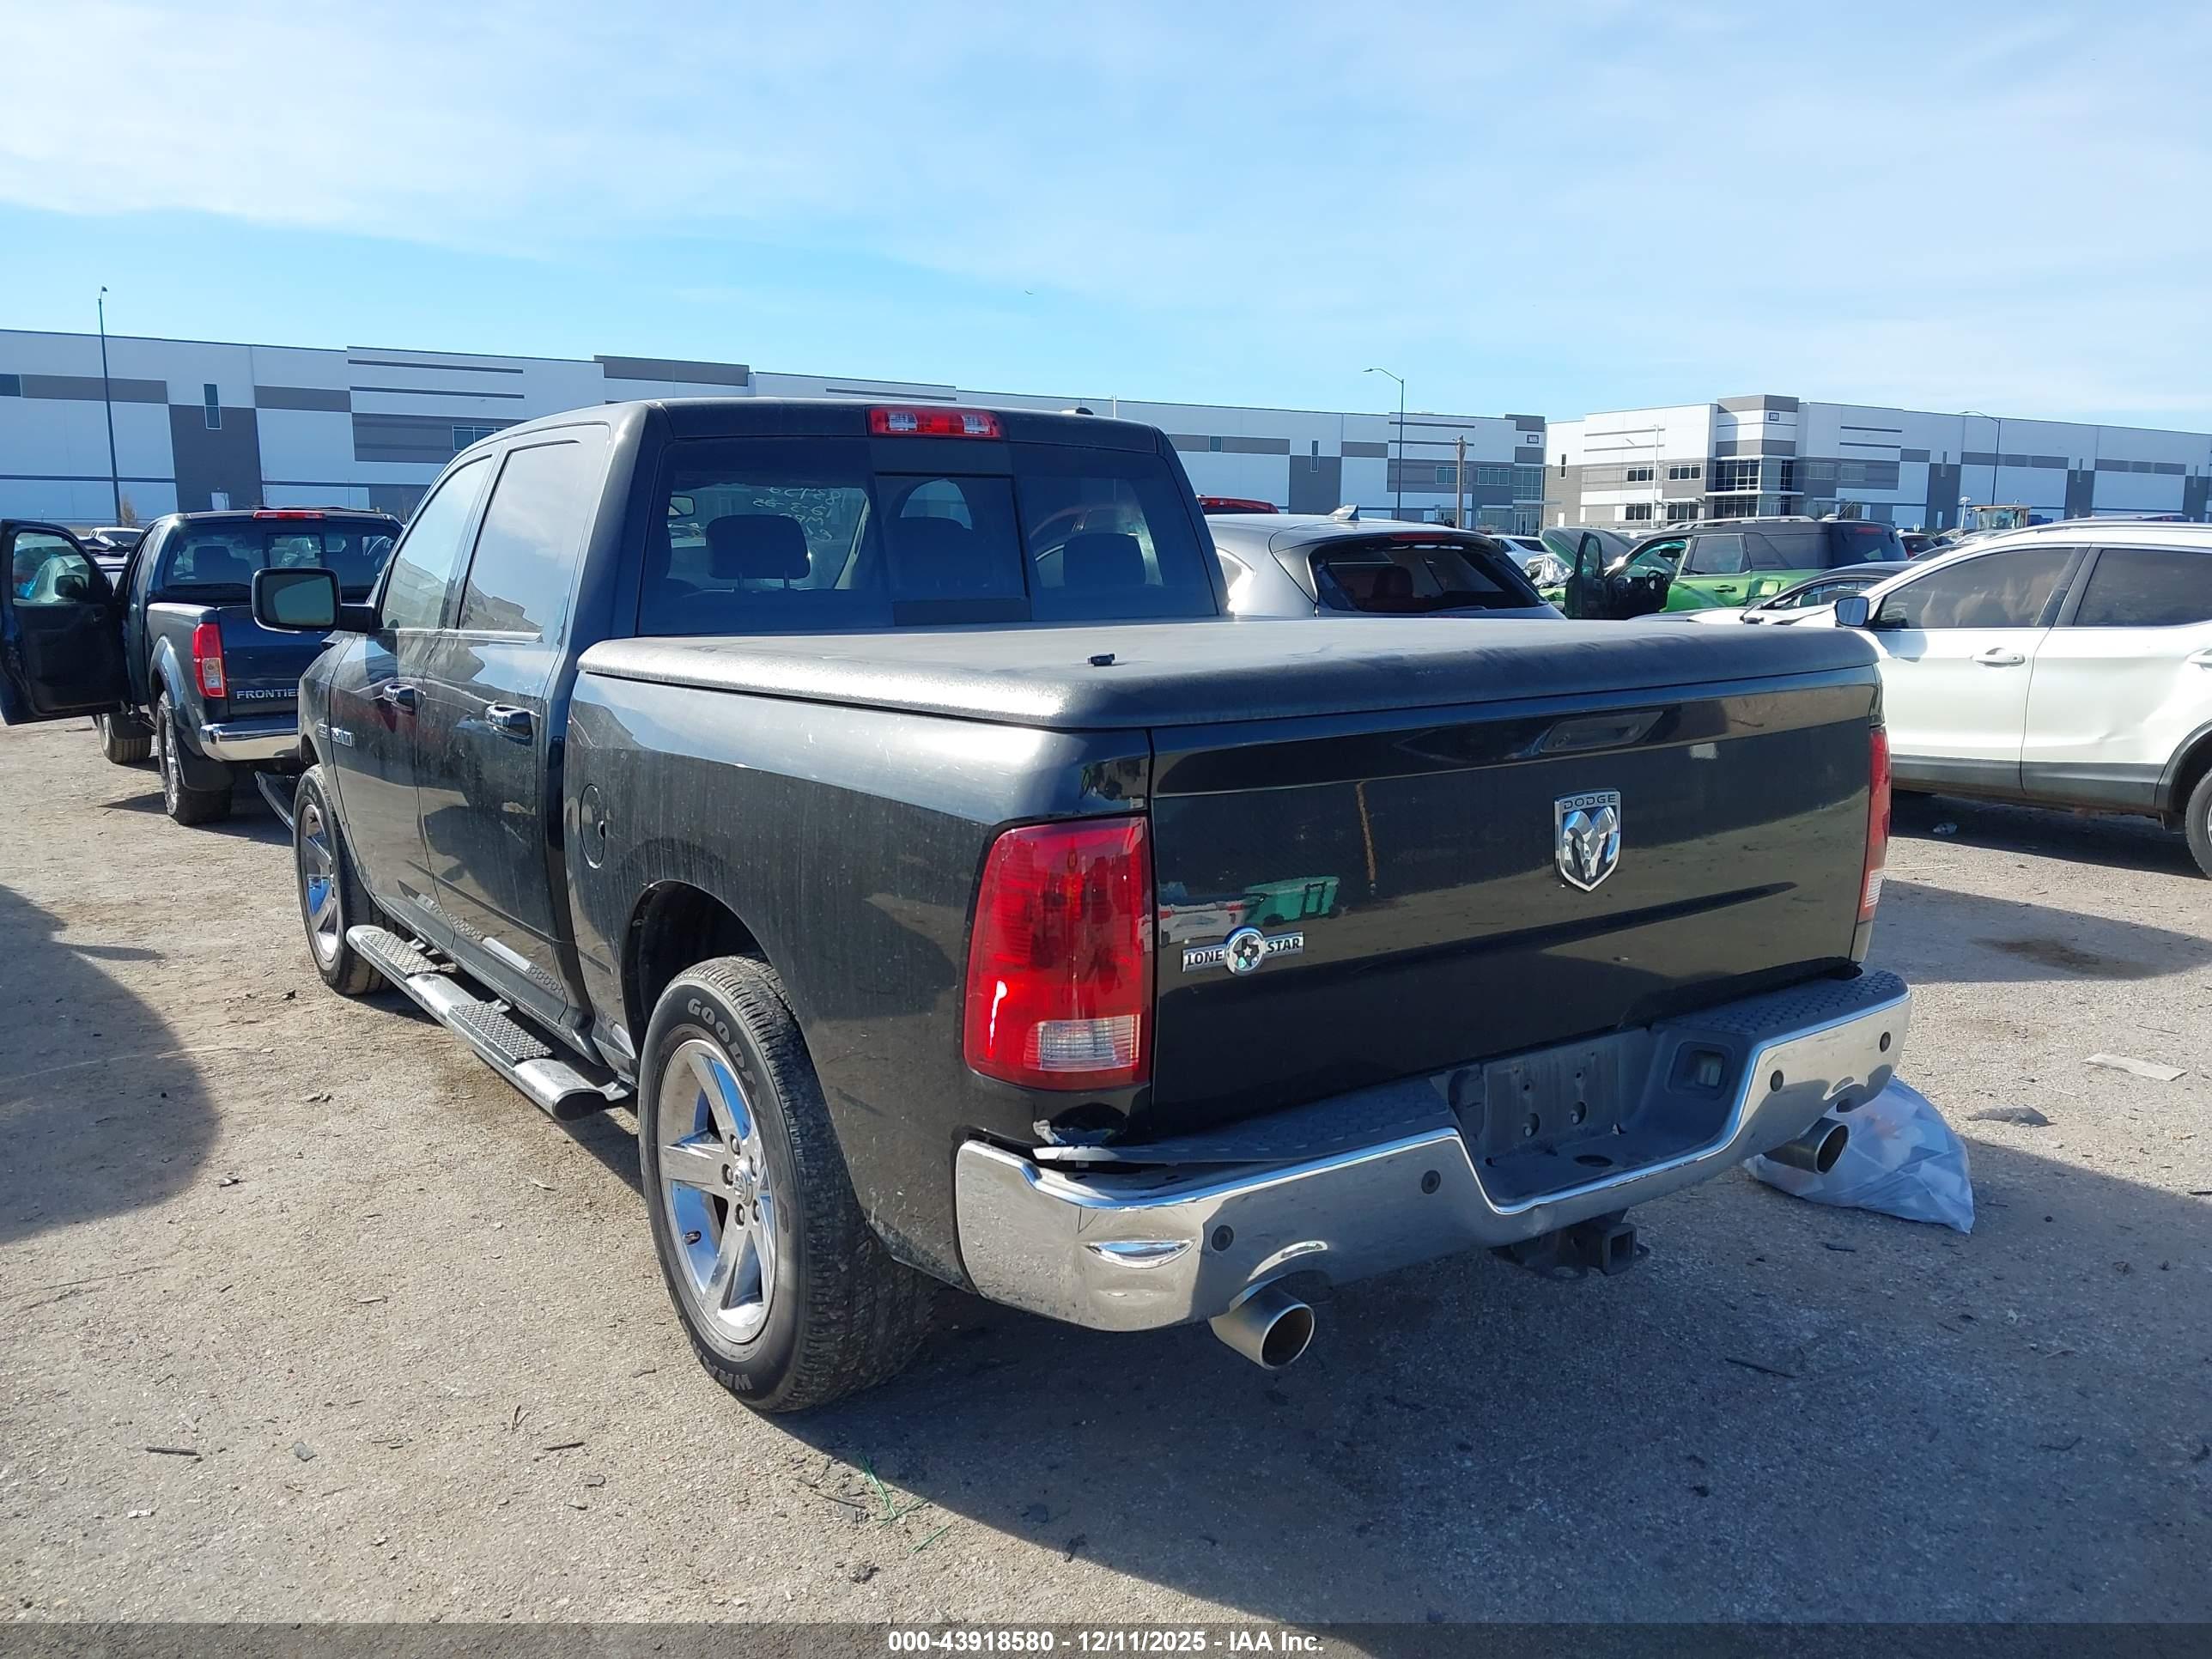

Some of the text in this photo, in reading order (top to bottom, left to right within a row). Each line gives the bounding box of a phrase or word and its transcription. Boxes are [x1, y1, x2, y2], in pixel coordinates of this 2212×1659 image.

[1564, 794, 1616, 810] DODGE
[1187, 937, 1300, 966] LONE STAR
